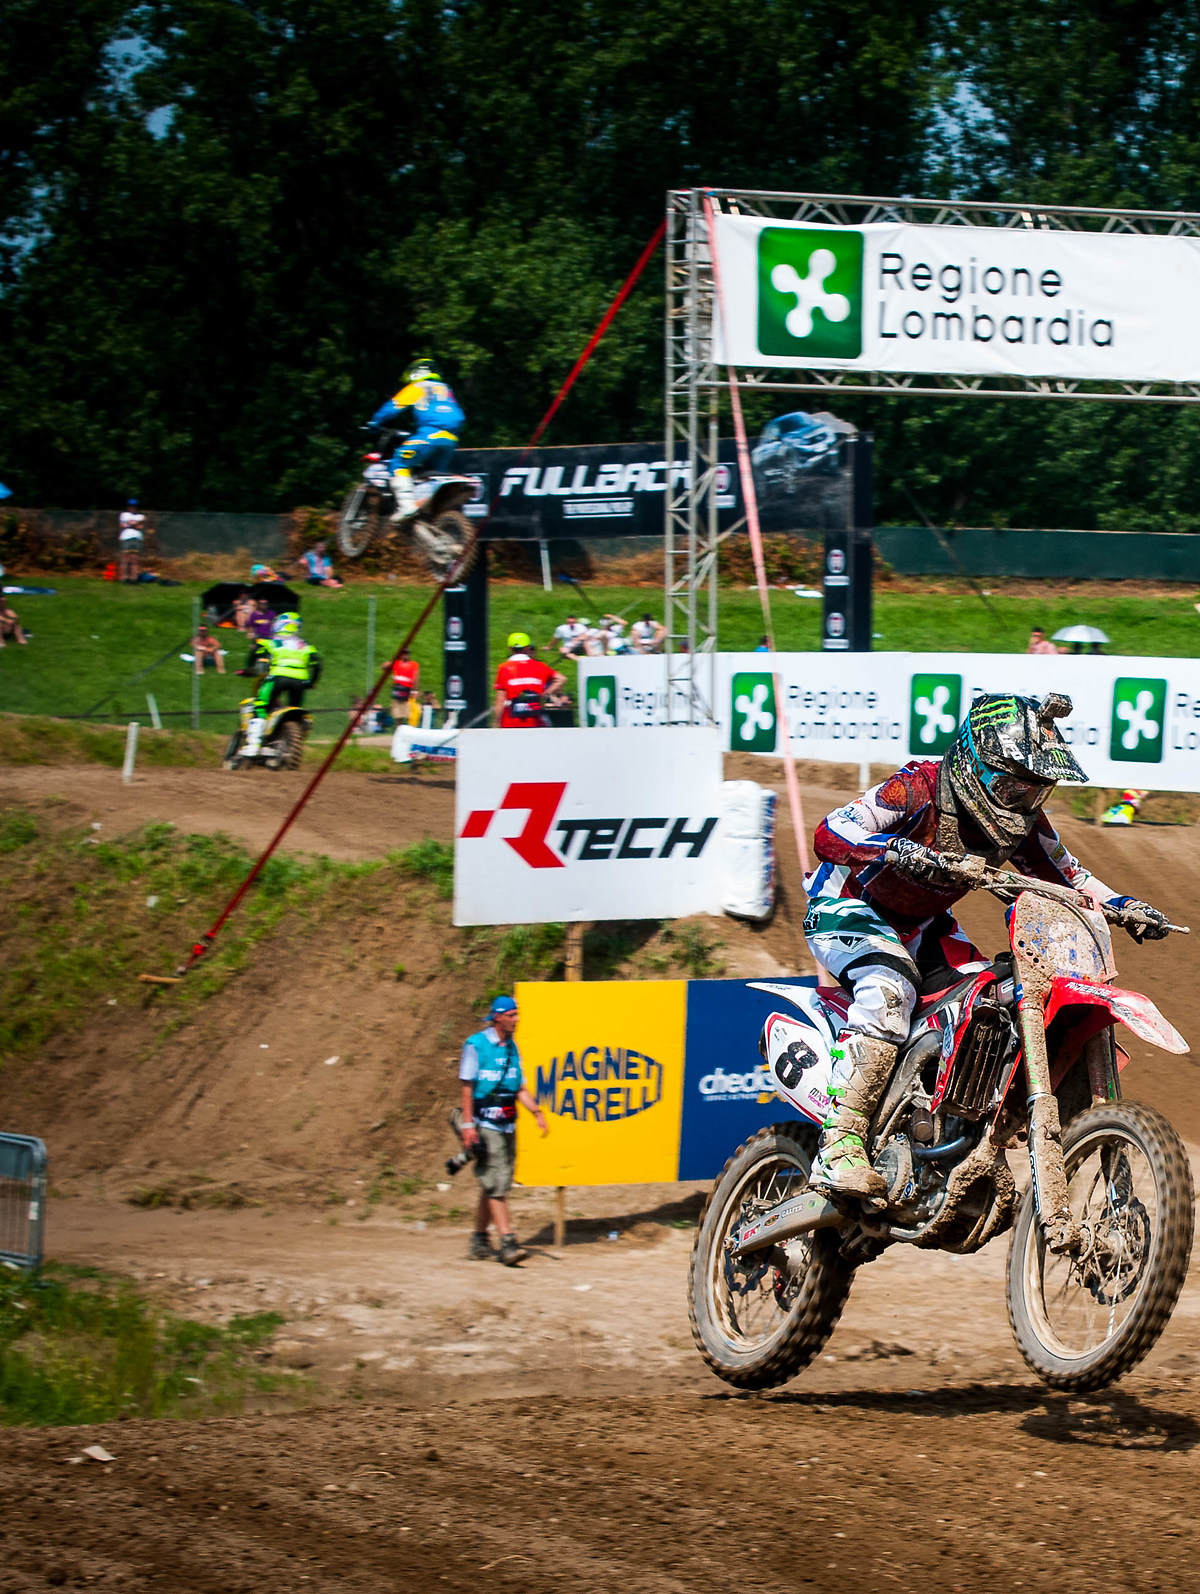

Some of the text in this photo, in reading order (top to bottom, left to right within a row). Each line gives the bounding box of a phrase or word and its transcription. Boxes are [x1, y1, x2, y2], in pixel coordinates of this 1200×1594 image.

[878, 252, 1063, 303] Regione
[878, 302, 1115, 348] Lombardia
[787, 685, 879, 714] Regione
[787, 717, 901, 740] Lombardia
[536, 1046, 663, 1084] MAGNETI
[775, 1040, 819, 1090] 8
[536, 1085, 663, 1122] MARELLI
